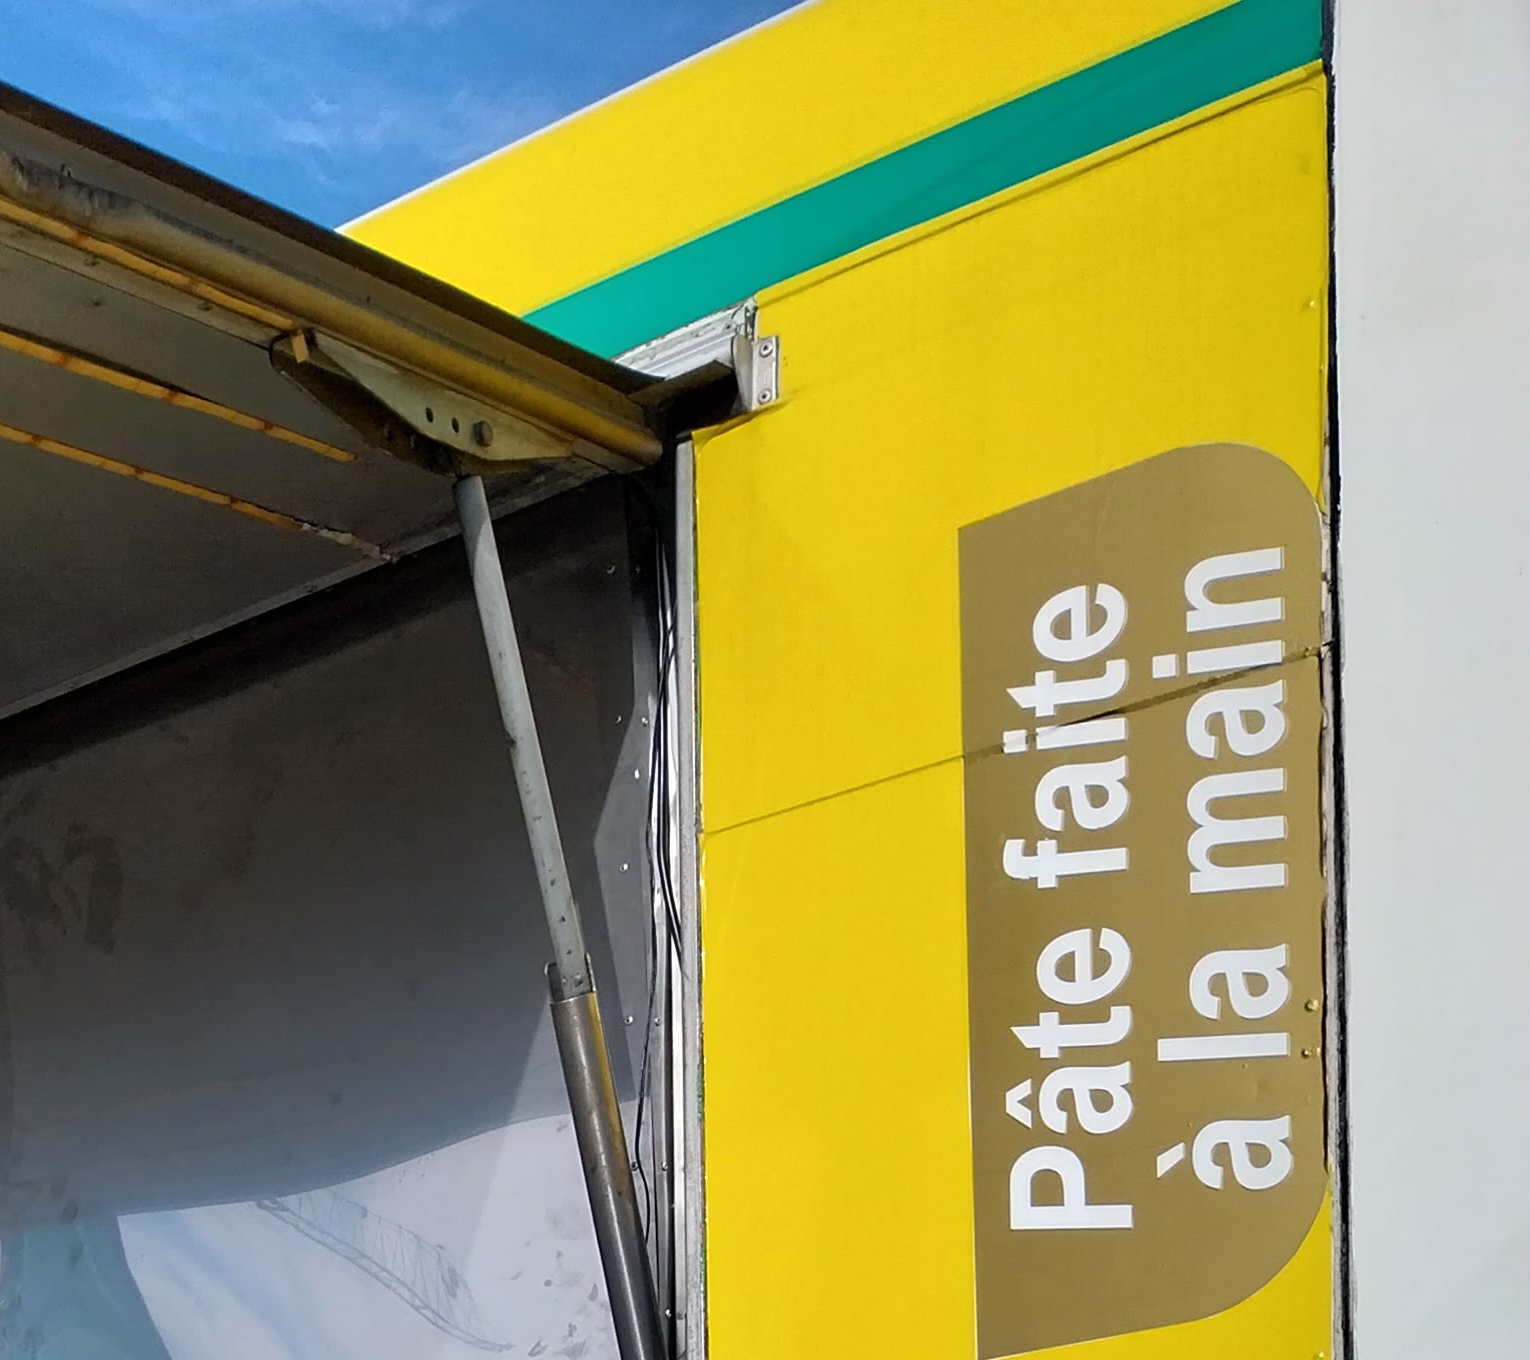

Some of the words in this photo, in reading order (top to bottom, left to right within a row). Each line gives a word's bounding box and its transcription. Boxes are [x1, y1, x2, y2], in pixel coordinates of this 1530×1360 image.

[1001, 580, 1131, 890] faite
[1151, 545, 1288, 895] main
[1004, 925, 1136, 1231] Pâte
[1156, 942, 1292, 1062] la
[1156, 1113, 1296, 1191] à
